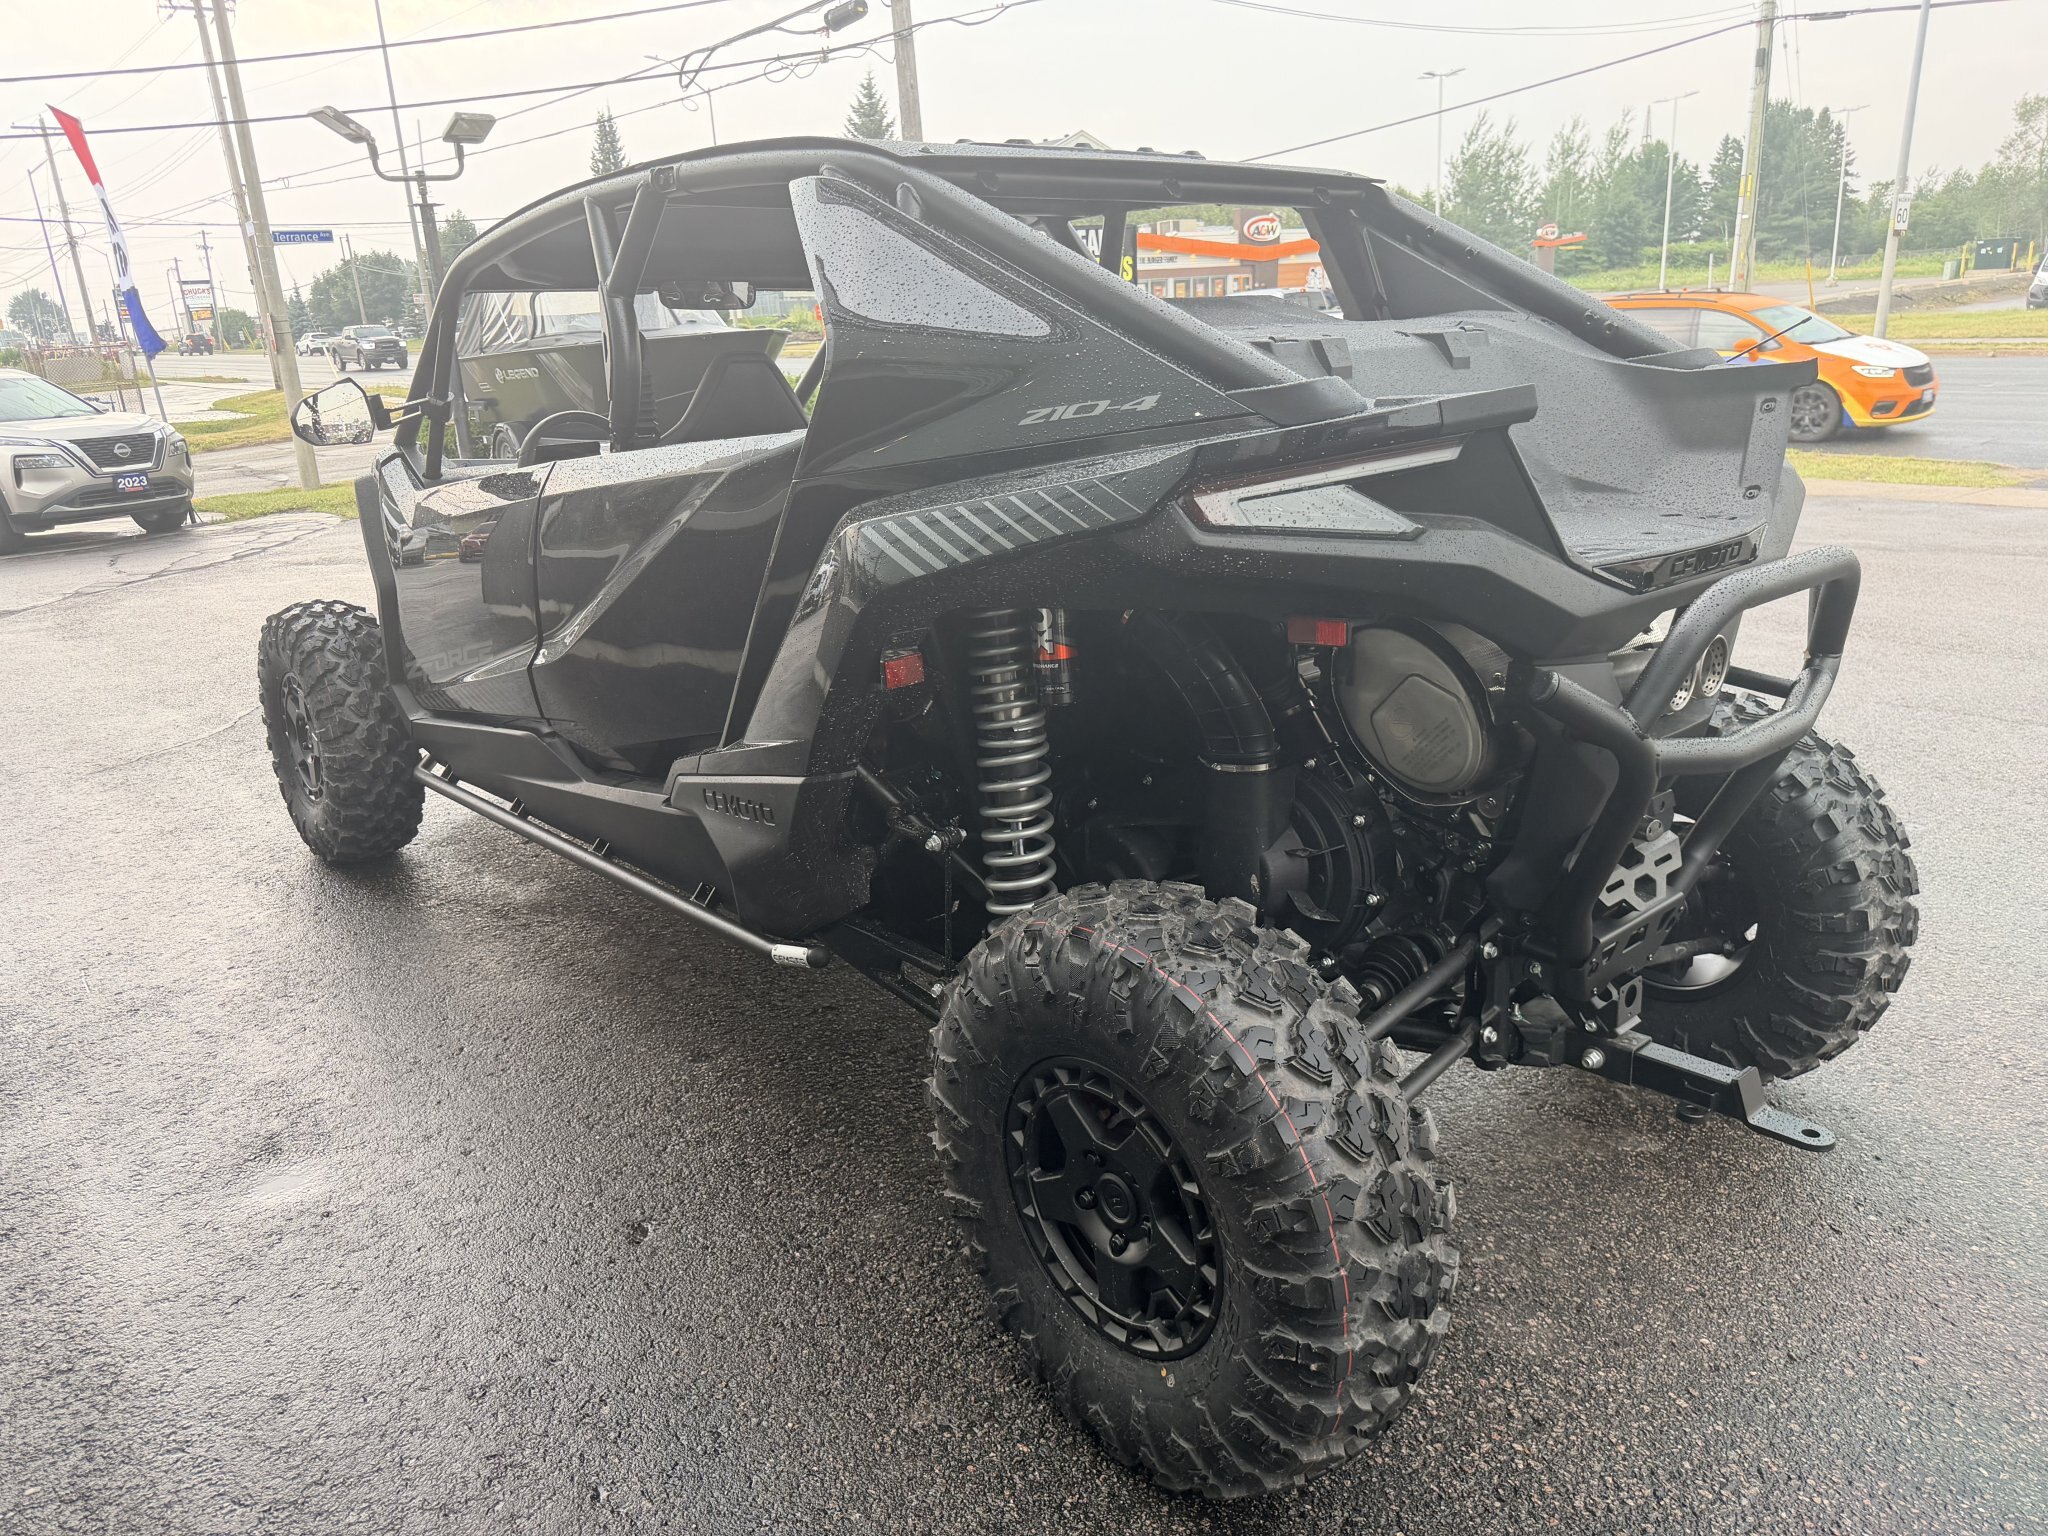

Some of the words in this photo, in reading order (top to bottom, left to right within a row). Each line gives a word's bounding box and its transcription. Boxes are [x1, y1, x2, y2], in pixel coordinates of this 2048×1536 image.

[1897, 207, 1908, 224] 60
[273, 231, 319, 242] Terrance
[1252, 224, 1279, 237] A&W
[503, 367, 540, 380] LEGEND
[117, 475, 148, 489] 2023
[1669, 540, 1744, 579] CFMOTO
[702, 788, 776, 827] CFMOTO
